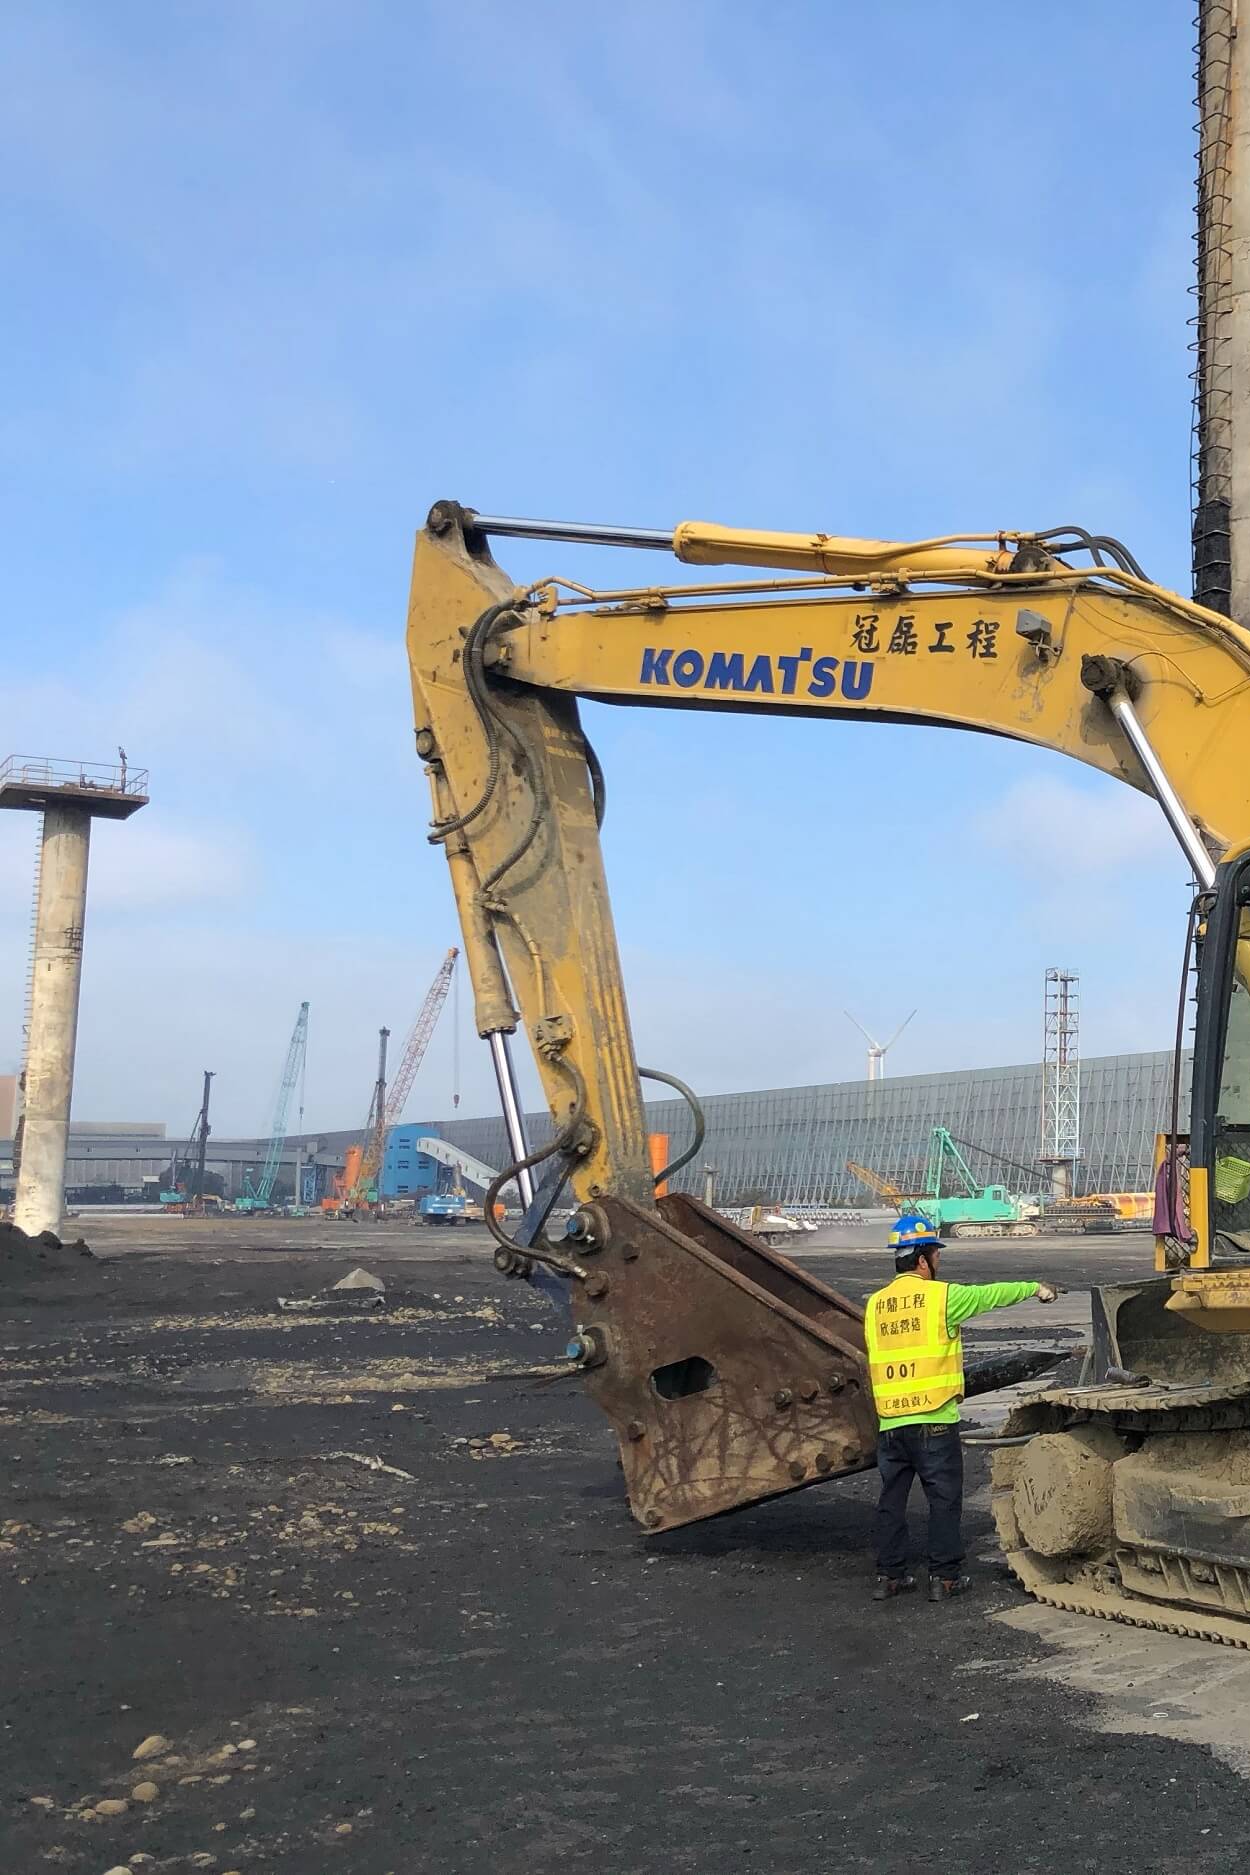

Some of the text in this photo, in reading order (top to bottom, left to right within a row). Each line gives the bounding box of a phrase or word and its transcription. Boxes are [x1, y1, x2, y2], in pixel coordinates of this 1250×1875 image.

[640, 647, 875, 700] KOMATSU
[883, 1394, 932, 1410] 工地負責人
